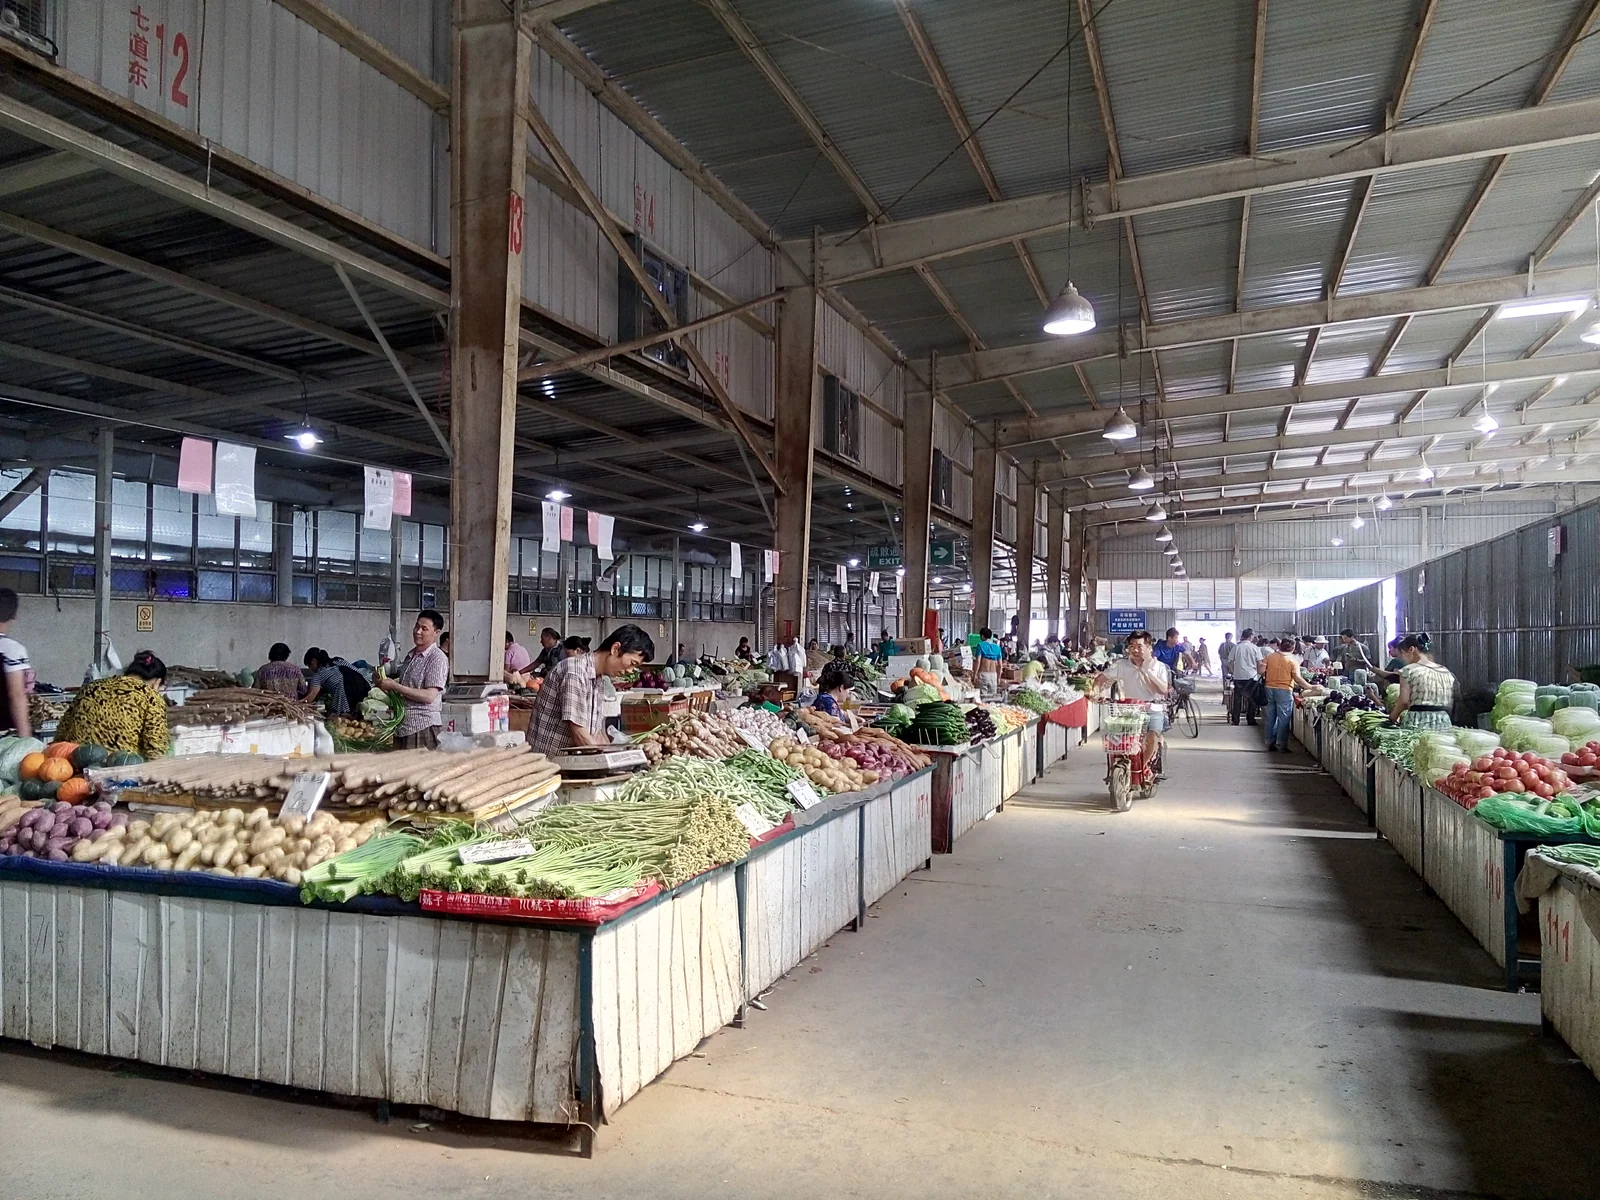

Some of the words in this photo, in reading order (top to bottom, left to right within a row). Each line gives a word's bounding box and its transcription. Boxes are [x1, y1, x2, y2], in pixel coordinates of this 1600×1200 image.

[129, 5, 149, 89] 七道东
[156, 24, 189, 108] 12
[509, 193, 523, 256] 13
[879, 557, 901, 566] EXIT
[419, 893, 443, 906] 妹子
[1547, 907, 1570, 963] 111
